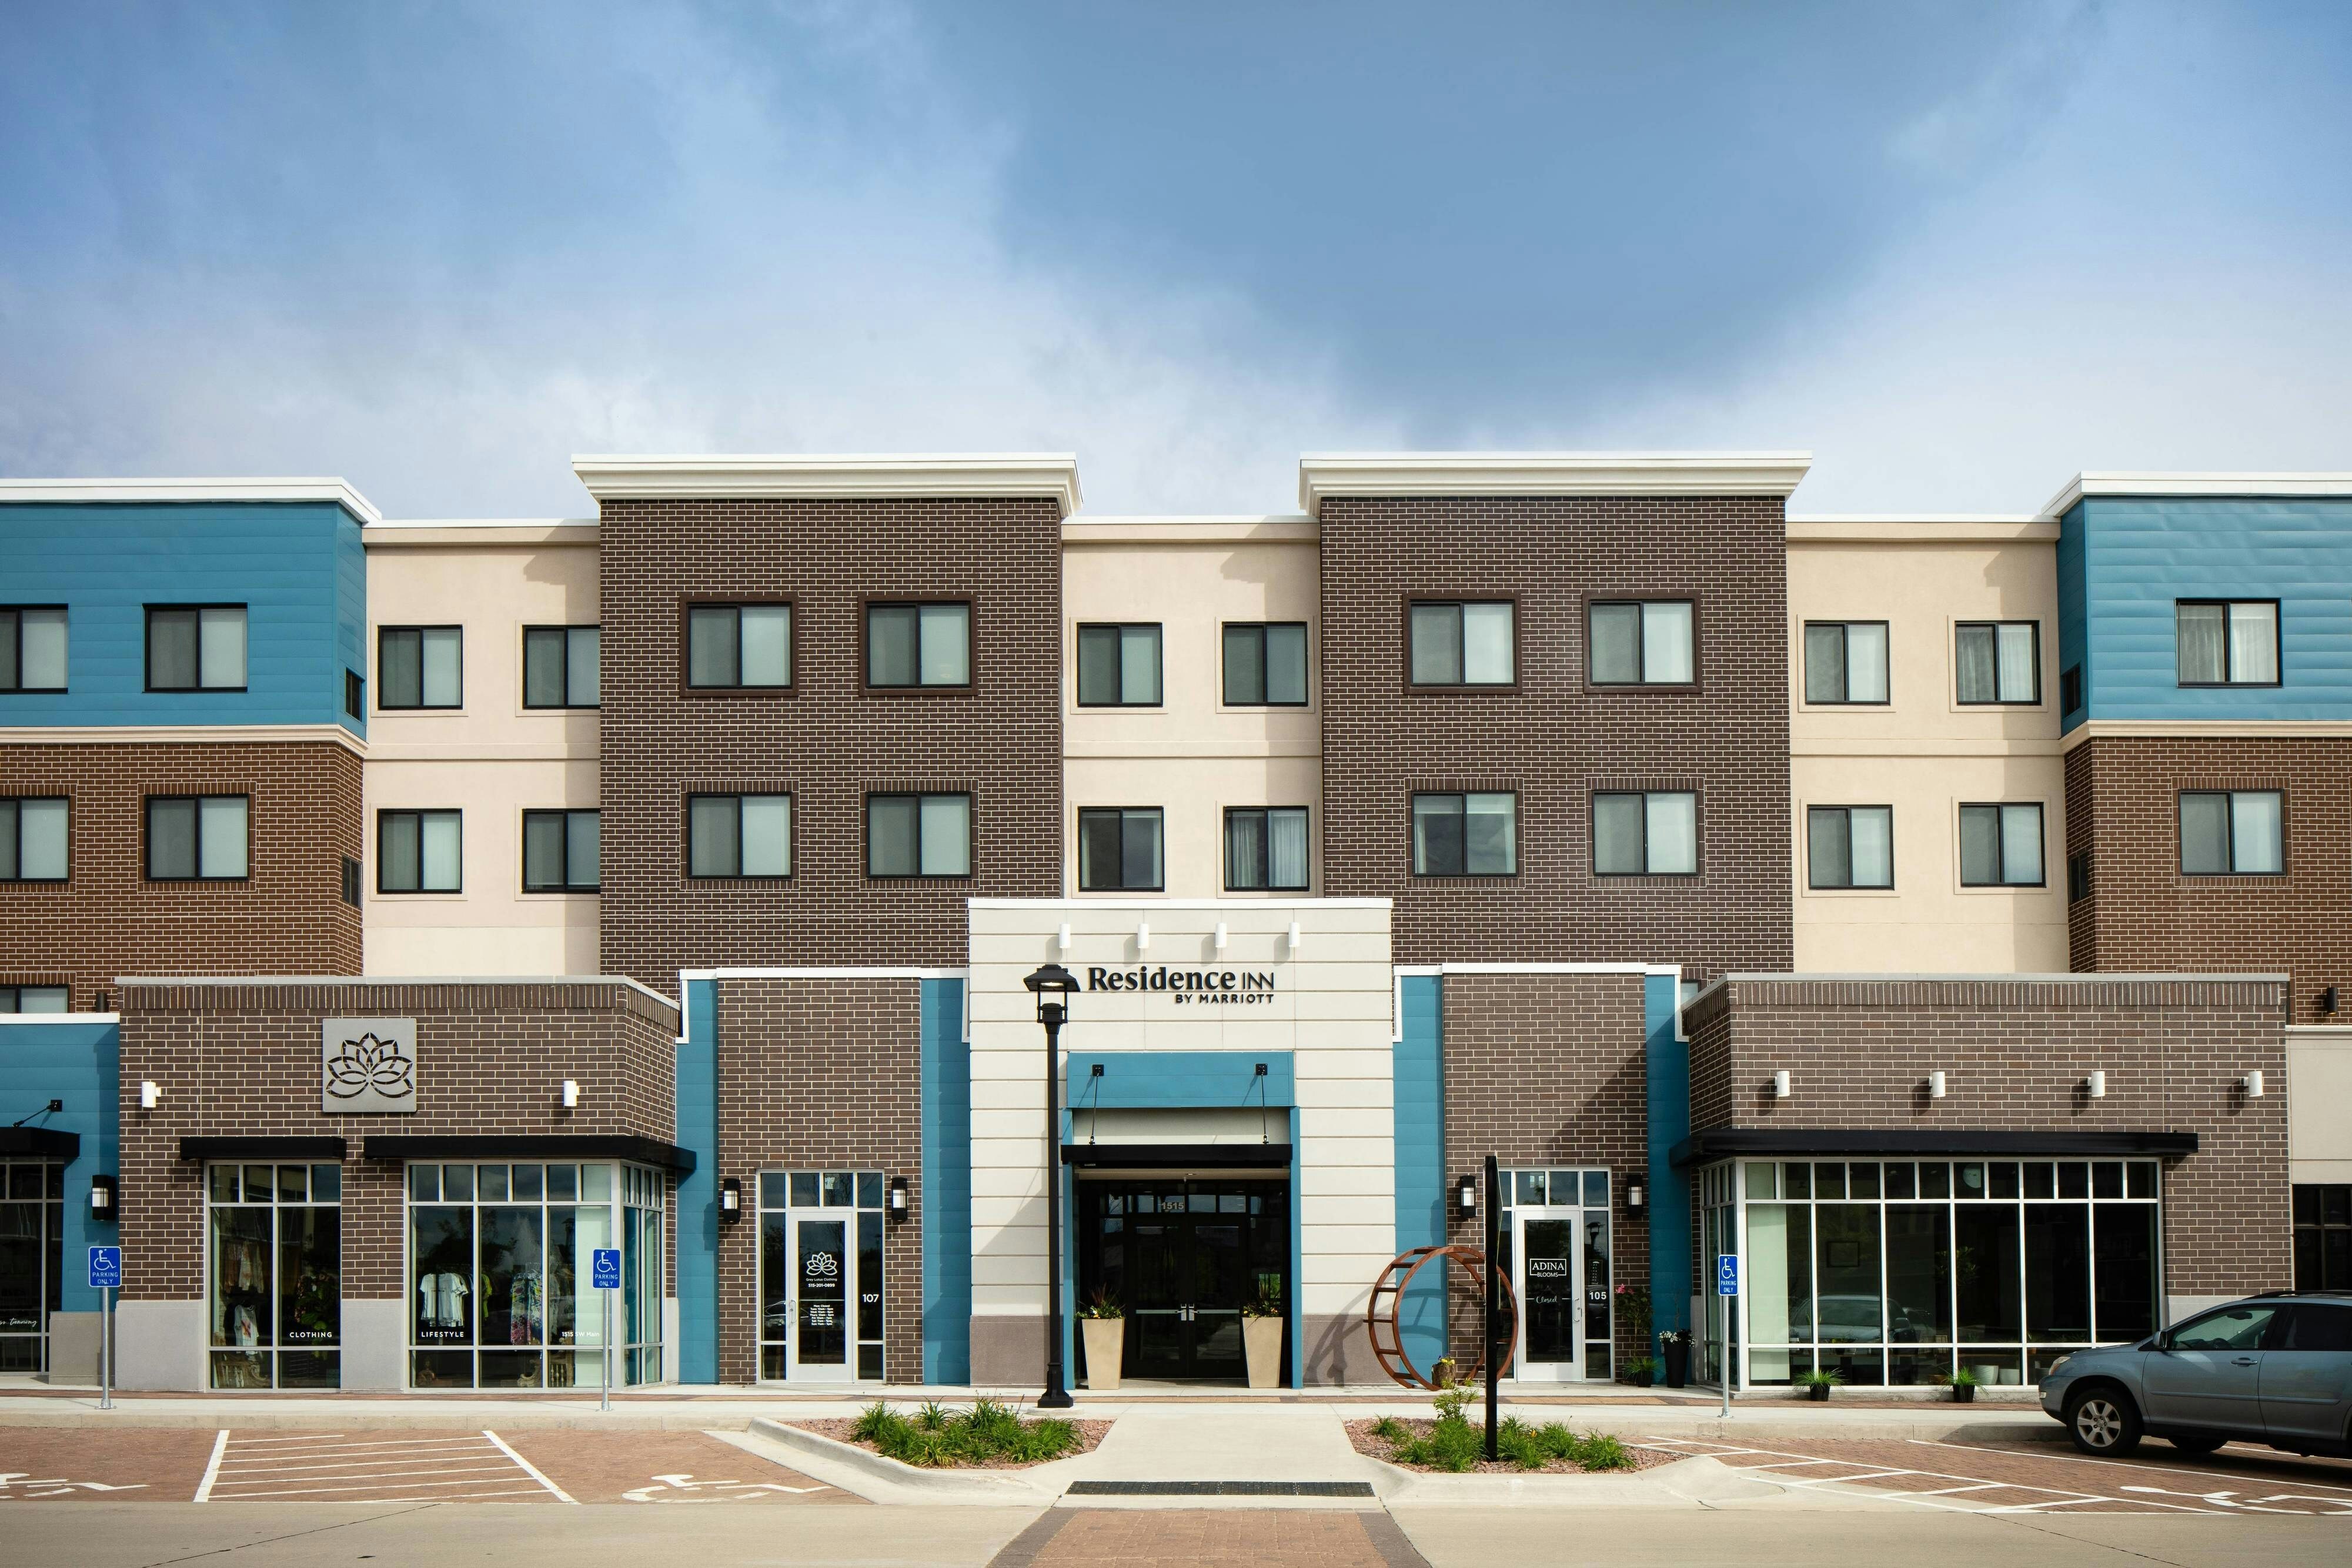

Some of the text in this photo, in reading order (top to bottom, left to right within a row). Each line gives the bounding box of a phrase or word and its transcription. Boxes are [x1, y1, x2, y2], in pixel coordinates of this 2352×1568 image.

[1088, 965, 1274, 991] Residence INN
[1175, 994, 1274, 1004] BY MARRIOTT
[1532, 1262, 1565, 1271] ADINA
[863, 1294, 879, 1303] 107
[1536, 1295, 1558, 1303] Closed
[1589, 1291, 1607, 1300] 105
[9, 1318, 37, 1327] tanning
